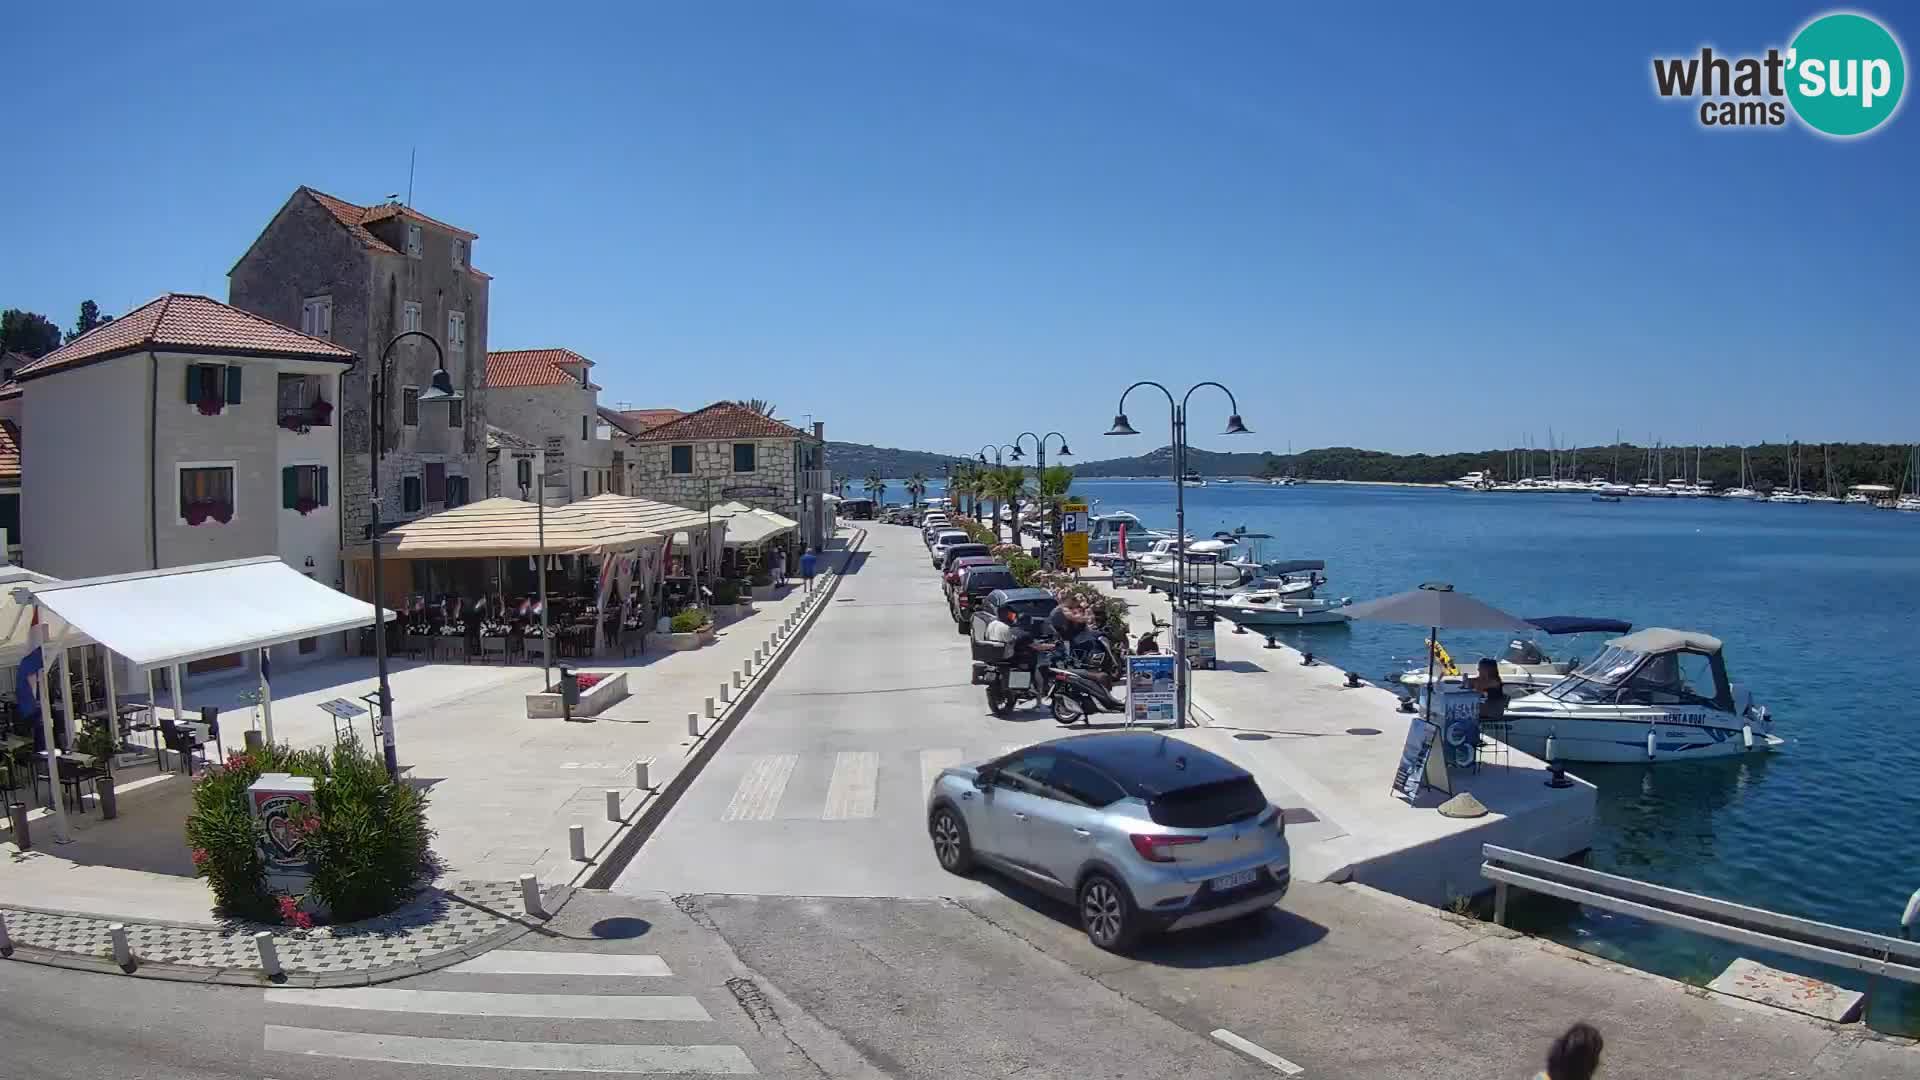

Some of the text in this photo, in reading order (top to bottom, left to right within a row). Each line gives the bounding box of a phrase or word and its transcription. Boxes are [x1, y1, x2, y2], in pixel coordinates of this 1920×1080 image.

[1065, 514, 1075, 530] P
[1664, 713, 1681, 722] RENT
[1689, 713, 1706, 725] BOAT
